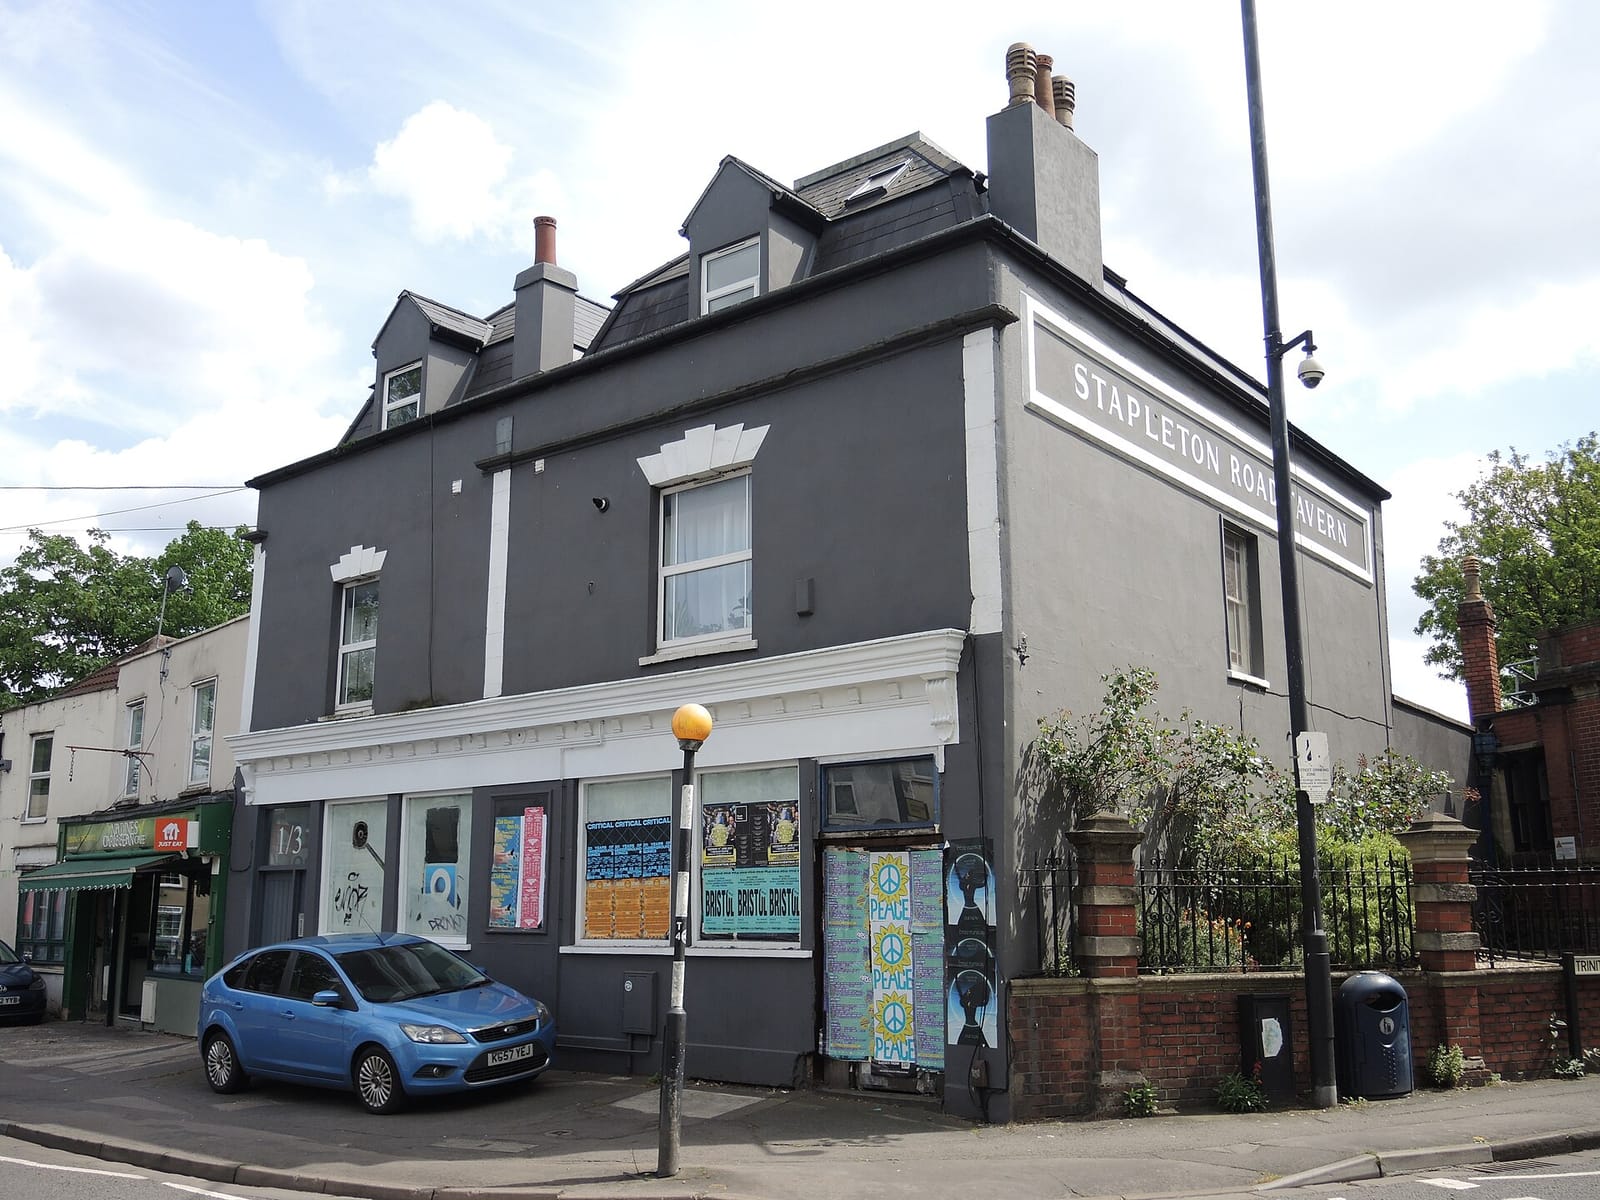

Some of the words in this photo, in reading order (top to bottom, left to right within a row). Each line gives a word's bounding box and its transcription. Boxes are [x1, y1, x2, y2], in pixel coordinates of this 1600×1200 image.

[1073, 362, 1220, 475] STAPLETON
[1290, 490, 1348, 548] AVERN
[587, 822, 614, 830] CRITICAL
[615, 819, 642, 828] CRITICAL
[642, 817, 672, 826] CRITICAL
[277, 825, 302, 855] 1/3
[705, 889, 734, 917] BRISTOL
[737, 888, 767, 917] BRISTOL
[769, 887, 800, 917] BRISTOL
[870, 898, 910, 921] PEACE
[873, 968, 913, 990] PEACE
[491, 1050, 514, 1064] KG57
[515, 1045, 531, 1058] YEJ
[875, 1036, 915, 1060] PEACE
